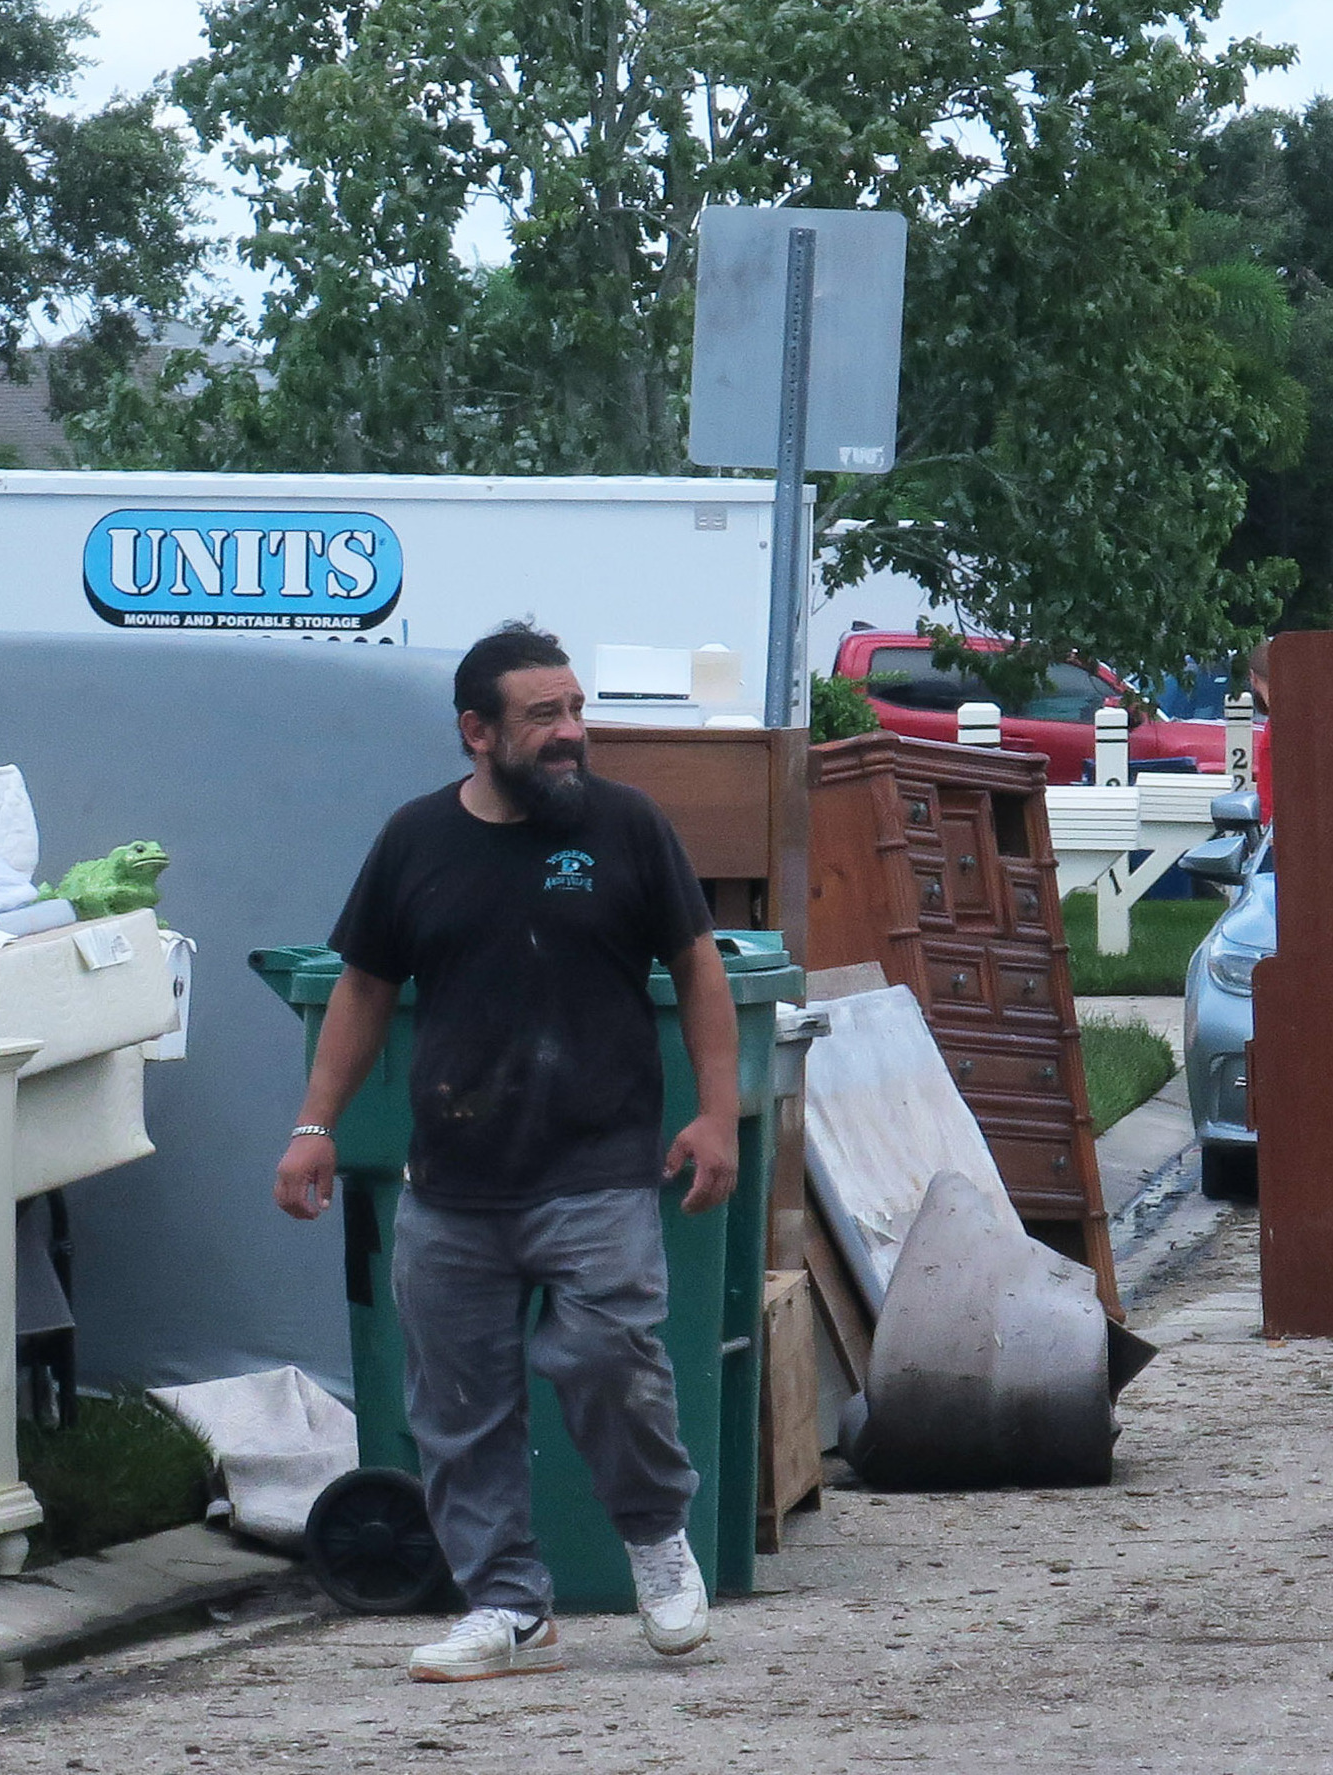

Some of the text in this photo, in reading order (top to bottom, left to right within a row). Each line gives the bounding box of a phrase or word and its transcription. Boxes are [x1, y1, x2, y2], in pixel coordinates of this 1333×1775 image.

[106, 527, 378, 599] UNITS
[123, 613, 362, 629] MOVING AND PORTABLE STORAGE
